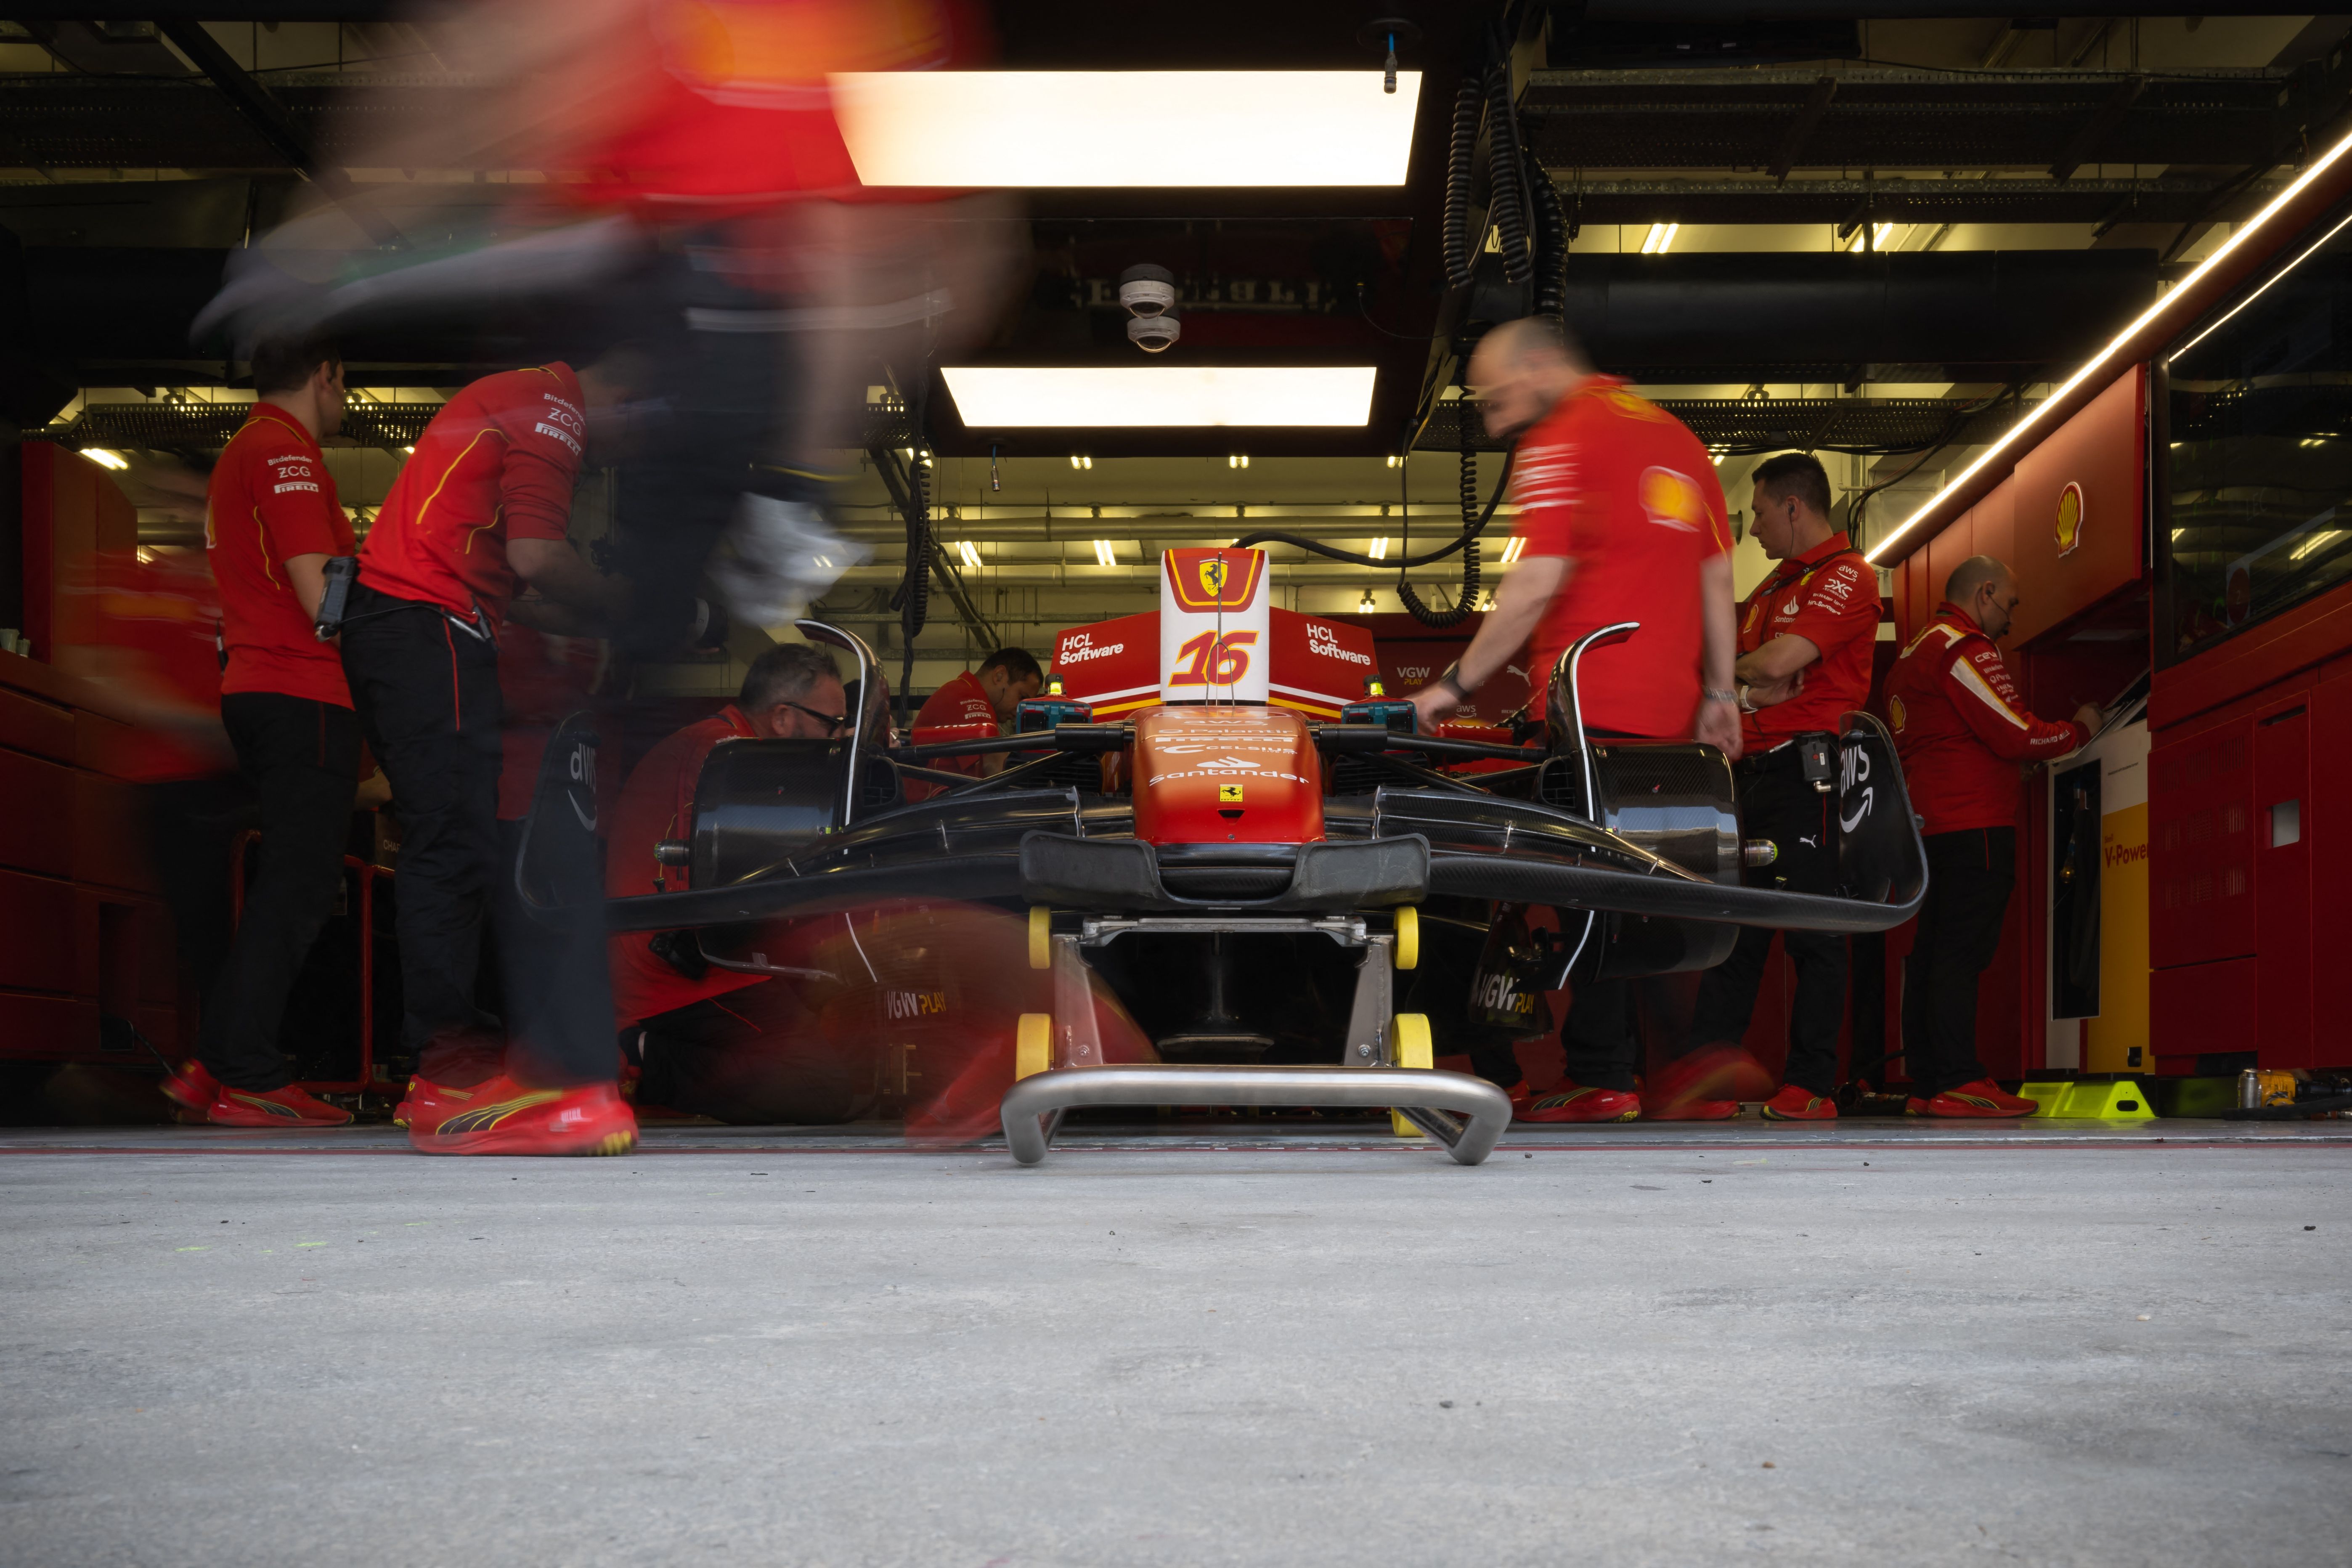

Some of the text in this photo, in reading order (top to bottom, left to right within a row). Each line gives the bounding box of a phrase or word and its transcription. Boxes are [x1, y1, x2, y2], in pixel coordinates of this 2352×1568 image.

[544, 393, 586, 426] Bitdefend
[548, 407, 582, 437] ZCG
[535, 422, 582, 456] PIRELLI
[268, 455, 313, 466] Bitdefender
[278, 466, 311, 478] ZCG
[274, 482, 319, 494] PIRELLI
[1838, 565, 1859, 578] aws
[1813, 593, 1833, 601] RCHARD
[1822, 587, 1847, 600] ECHNOLOGY
[1824, 578, 1853, 598] DXC
[1062, 633, 1093, 651] HCL
[1307, 623, 1338, 644] HCL
[1059, 643, 1124, 665] Software
[1168, 630, 1260, 687] 16
[1310, 639, 1371, 666] Software
[1397, 667, 1430, 678] VGW
[964, 711, 992, 720] PIRELLI
[2030, 735, 2058, 745] RICHARD
[1149, 769, 1309, 787] Santander
[1840, 744, 1870, 798] aws
[1477, 974, 1535, 1014] VGW PLAY
[887, 991, 947, 1019] VGW PLAY
